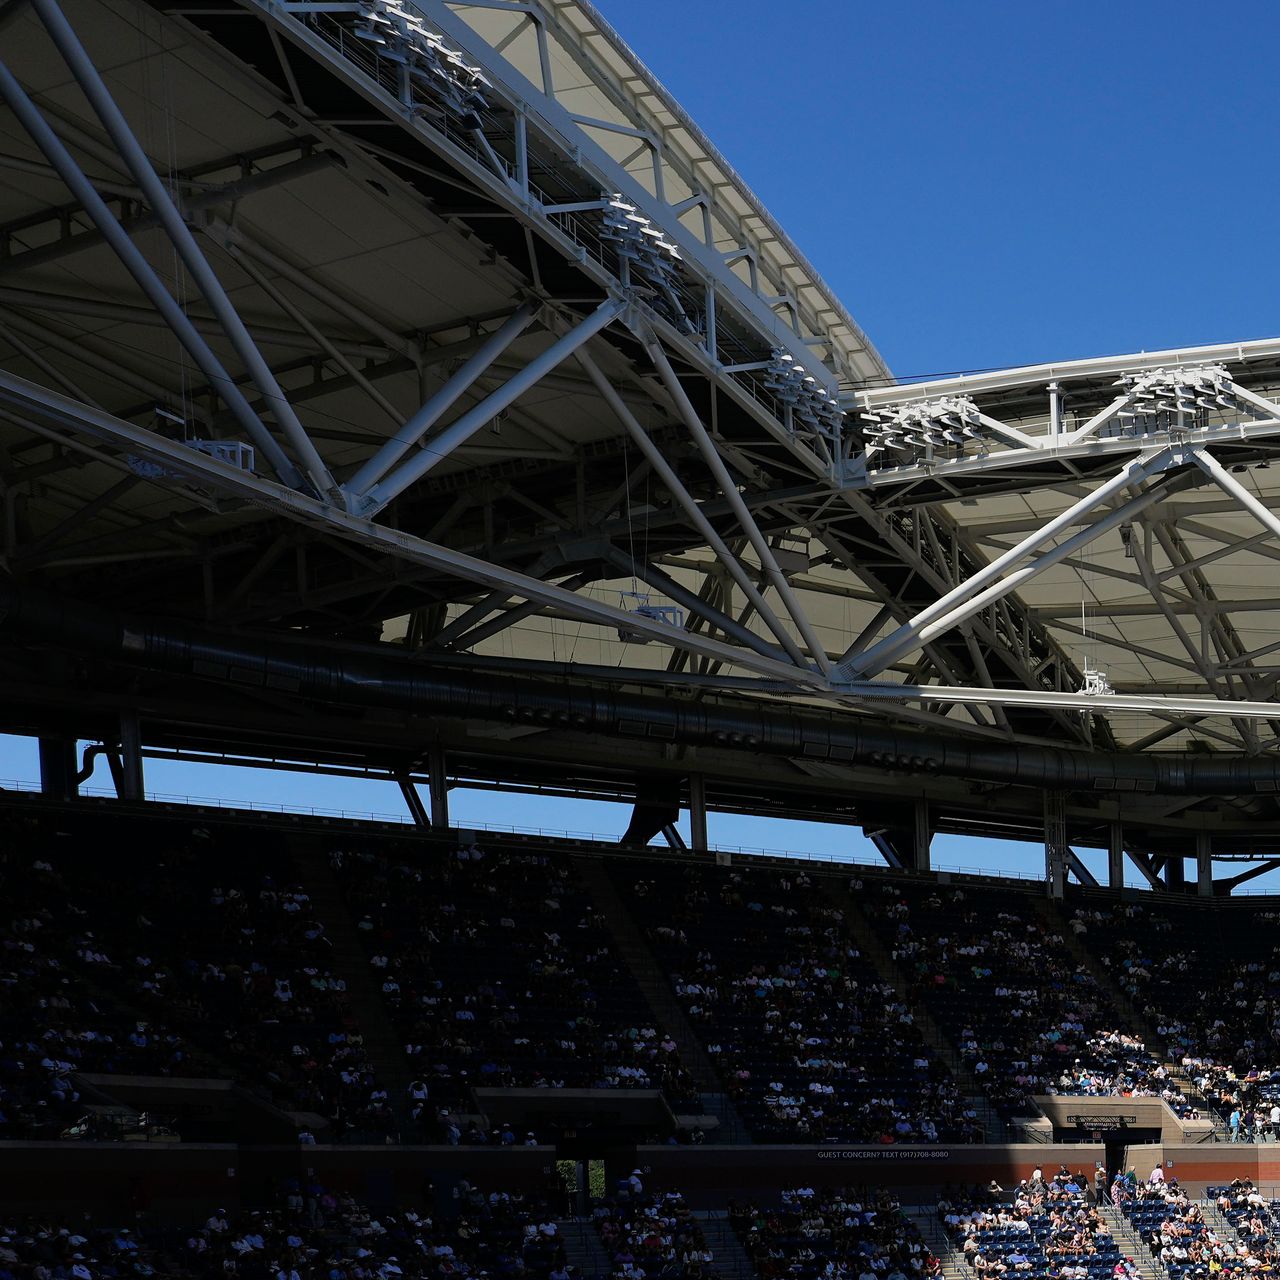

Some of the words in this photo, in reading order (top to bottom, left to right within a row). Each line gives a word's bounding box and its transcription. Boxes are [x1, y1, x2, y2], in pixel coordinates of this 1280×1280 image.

[817, 1151, 841, 1159] GUEST
[842, 1151, 880, 1159] CONCERN?
[882, 1151, 899, 1159] TEXT
